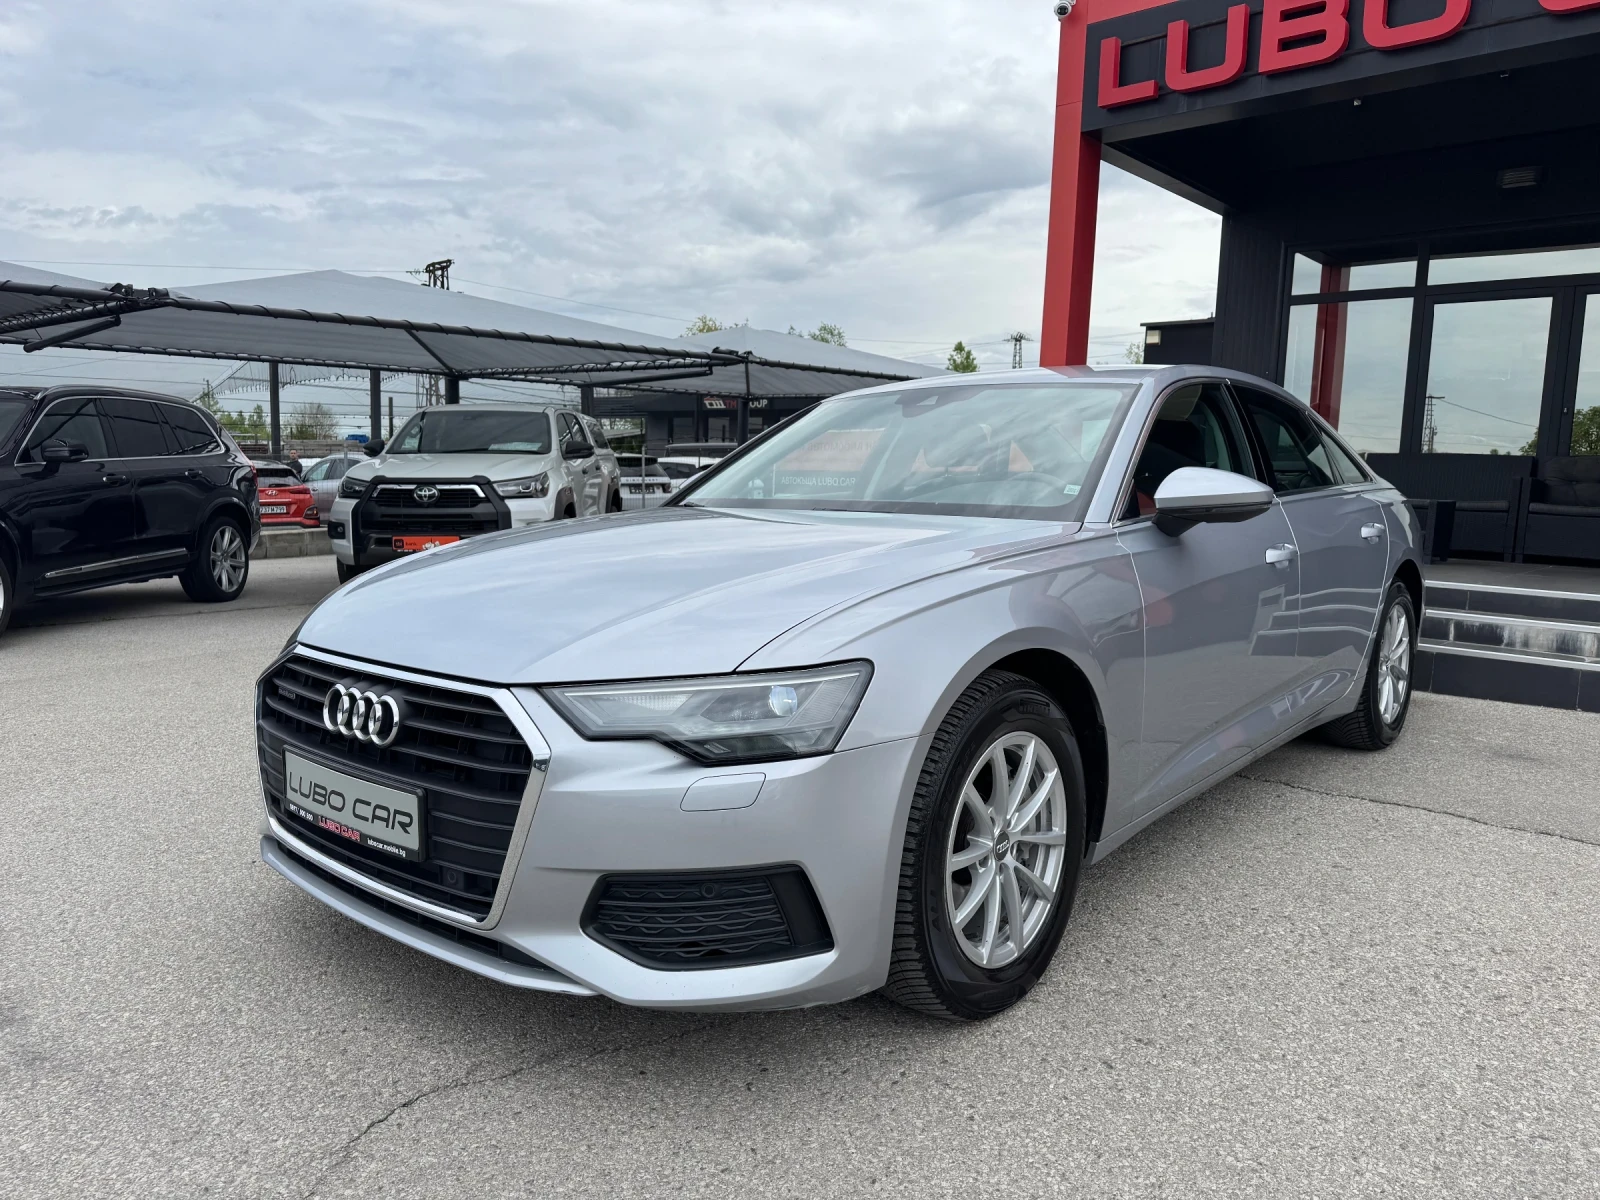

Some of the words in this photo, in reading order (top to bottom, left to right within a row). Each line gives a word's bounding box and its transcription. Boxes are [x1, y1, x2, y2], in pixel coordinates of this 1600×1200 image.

[817, 476, 839, 486] LUBO
[839, 477, 856, 486] CAR
[289, 771, 346, 813] LUBO
[352, 798, 414, 835] CAR
[318, 815, 341, 834] LUBO
[341, 825, 360, 842] CAR
